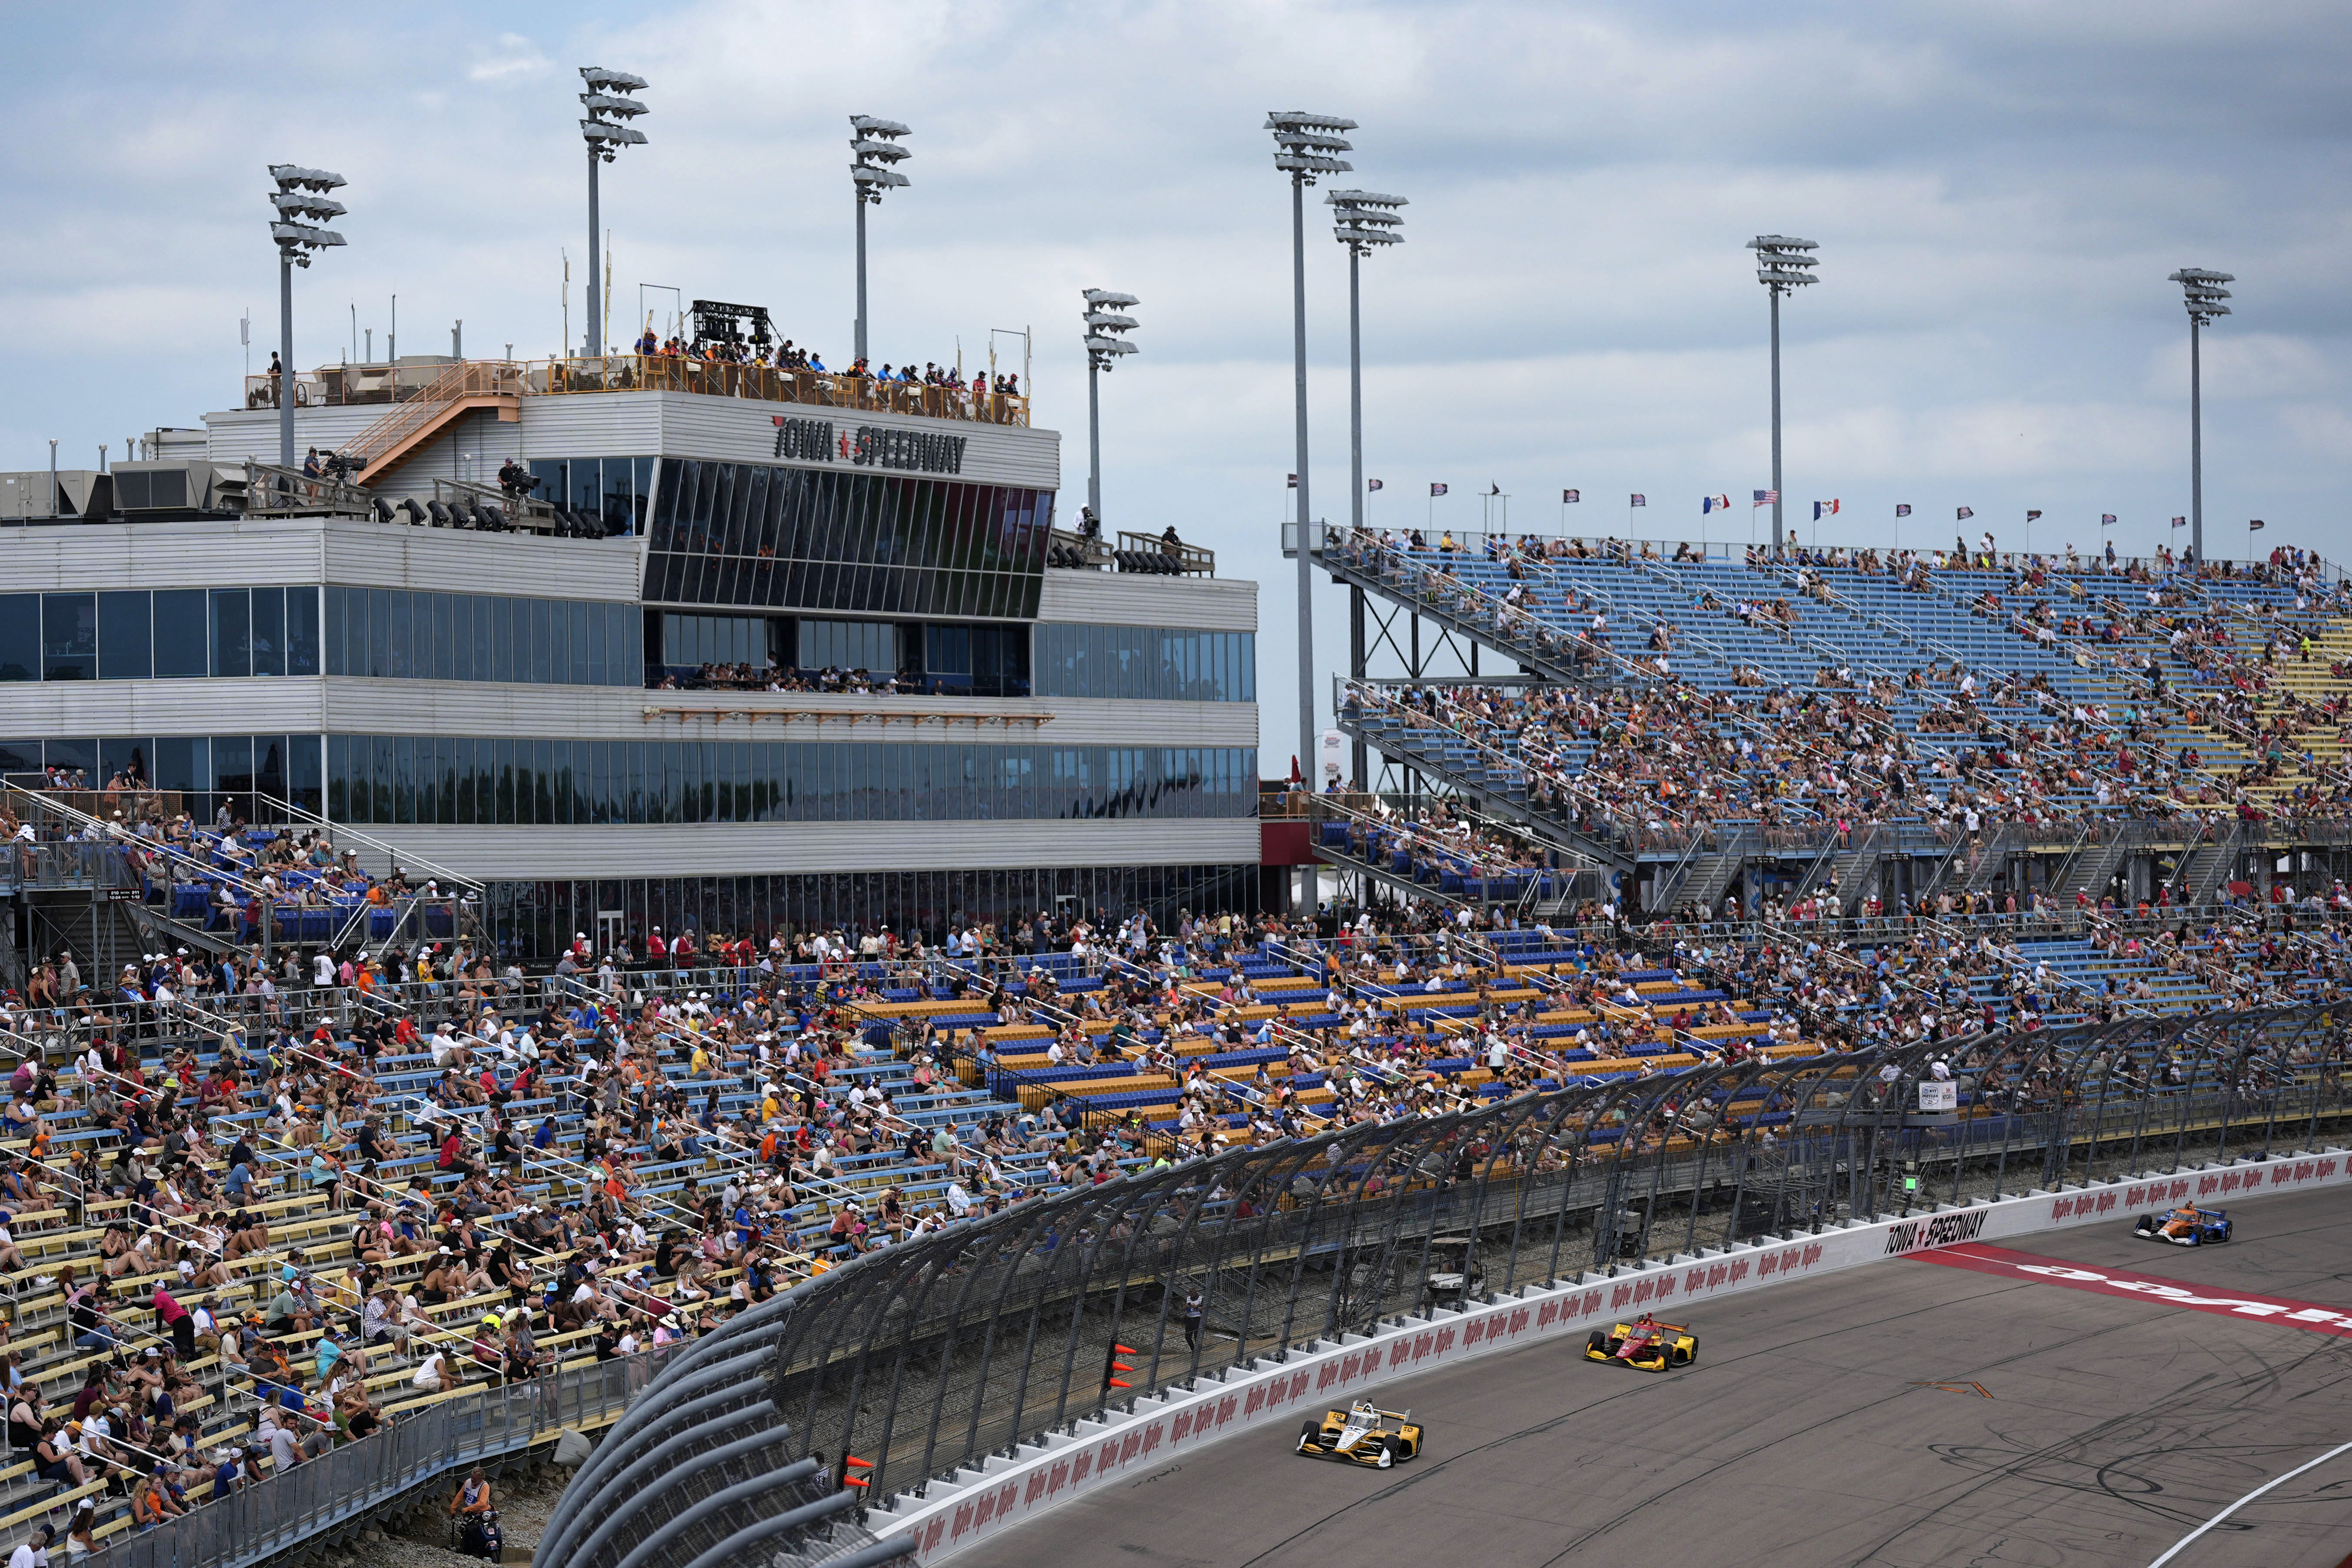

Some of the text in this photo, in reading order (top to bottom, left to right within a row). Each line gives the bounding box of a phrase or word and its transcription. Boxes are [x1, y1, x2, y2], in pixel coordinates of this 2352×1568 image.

[772, 415, 967, 474] IOWA SPEEDWAY
[2198, 1168, 2263, 1197] HyVee HyVee HyVee
[2271, 1165, 2292, 1186] HyVee
[2293, 1162, 2314, 1183] HyVee
[2315, 1159, 2336, 1180] HyVee
[2052, 1192, 2117, 1222] HyVee HyVee HyVee
[2126, 1180, 2189, 1210] HyVee HyVee HyVee
[1884, 1210, 1988, 1254] IOWA SPEEDWAY
[1684, 1259, 1749, 1297] HyVee HyVee HyVee
[1758, 1243, 1822, 1280] HyVee HyVee HyVee
[1537, 1290, 1603, 1331] HyVee HyVee HyVee
[1610, 1274, 1676, 1313] HyVee HyVee HyVee
[1390, 1327, 1455, 1371] HyVee HyVee HyVee
[1462, 1307, 1530, 1350] HyVee HyVee HyVee
[1317, 1348, 1382, 1394] HyVee HyVee HyVee
[1244, 1371, 1310, 1419] HyVee HyVee HyVee
[1170, 1395, 1238, 1447] HyVee HyVee HyVee
[1097, 1422, 1164, 1478] HyVee HyVee HyVee
[466, 1494, 474, 1503] 23
[1025, 1450, 1093, 1509] HyVee HyVee HyVee
[951, 1482, 1018, 1545] HyVee HyVee HyVee
[922, 1515, 945, 1560] HyVee
